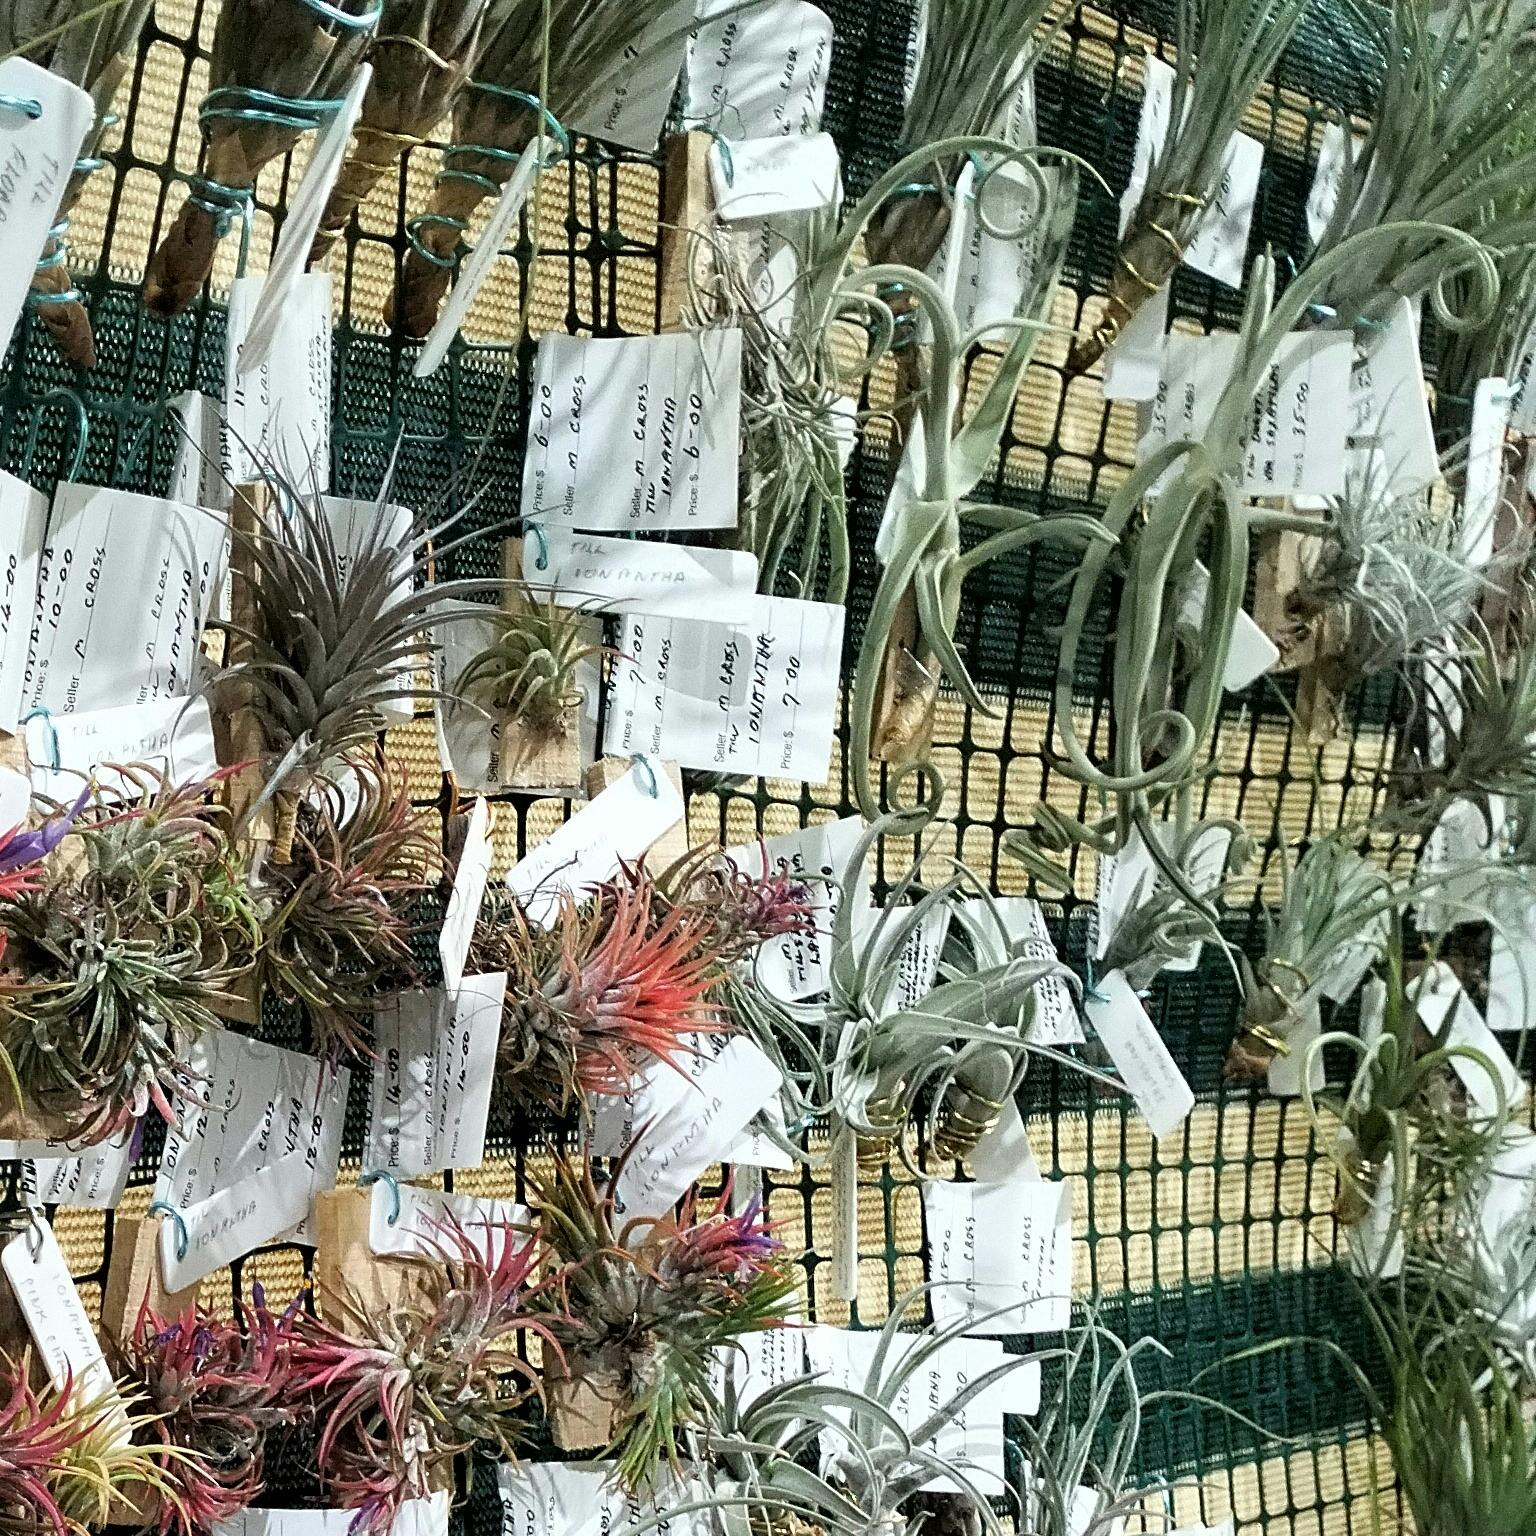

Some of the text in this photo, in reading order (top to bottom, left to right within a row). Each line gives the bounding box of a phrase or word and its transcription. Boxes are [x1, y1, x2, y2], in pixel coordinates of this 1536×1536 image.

[532, 384, 552, 511] Price: 6-00
[568, 375, 586, 433] CROSS
[630, 383, 648, 518] Seller M CROSS
[563, 485, 575, 516] Seller
[687, 394, 702, 516] Price: 6-00
[0, 554, 18, 633] 14-00
[31, 548, 73, 710] Price: 10-00
[64, 547, 105, 712] Seller M CROSS
[151, 559, 169, 618] CROSS
[650, 639, 672, 754] Seller CROSS
[714, 642, 738, 762] Seller M CROSS
[748, 635, 775, 744] IONANTHA
[782, 656, 802, 705] 7-00
[781, 740, 793, 769] Price:
[259, 1100, 274, 1150] CROSS
[305, 1115, 322, 1169] 12-00
[386, 1048, 399, 1167] Price: 14-00
[423, 1051, 434, 1165] Seller CROSS
[88, 1168, 101, 1199] Price:
[180, 1179, 195, 1209] Price:
